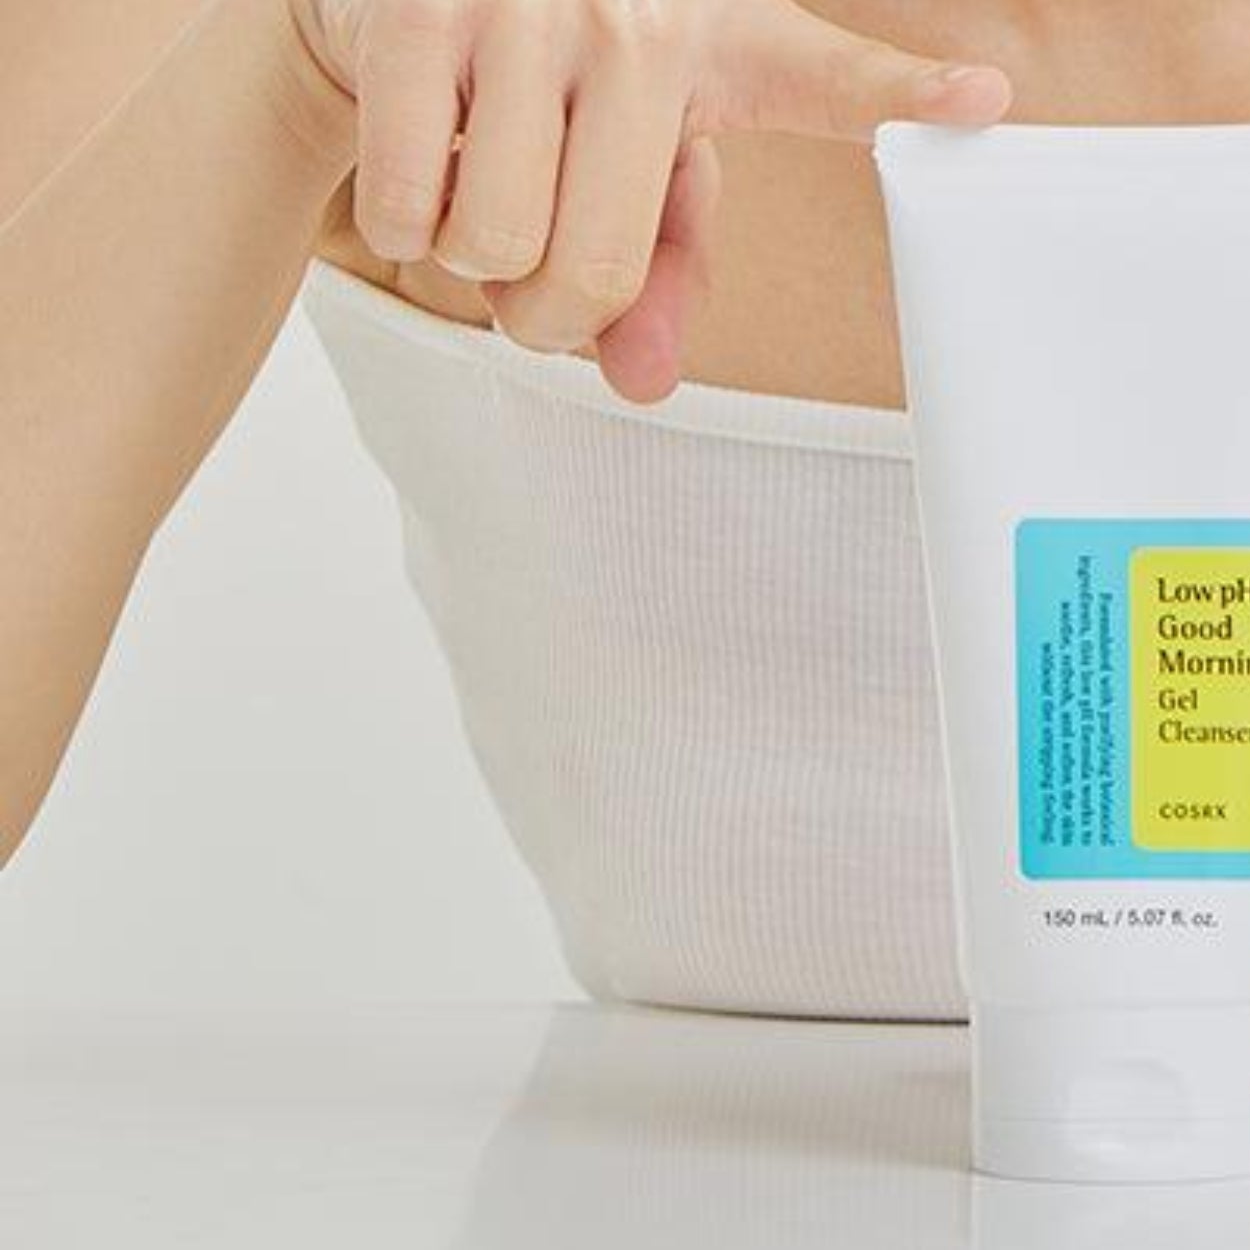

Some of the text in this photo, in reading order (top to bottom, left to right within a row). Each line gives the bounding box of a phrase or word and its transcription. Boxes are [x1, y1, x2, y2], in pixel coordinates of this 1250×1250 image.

[1158, 578, 1212, 603] Low
[1158, 616, 1233, 640] Good
[1100, 677, 1113, 708] with
[1158, 690, 1198, 710] Gel
[1079, 700, 1093, 720] pH
[1062, 712, 1075, 737] and
[1080, 725, 1094, 779] formula
[1097, 712, 1113, 777] purifying
[1062, 790, 1075, 810] the
[1081, 785, 1094, 825] works
[1159, 804, 1227, 819] COSRX
[1099, 782, 1114, 846] botanical
[1081, 830, 1093, 846] to
[1044, 911, 1219, 927] 150 mL / 5.07 fl. oz.
